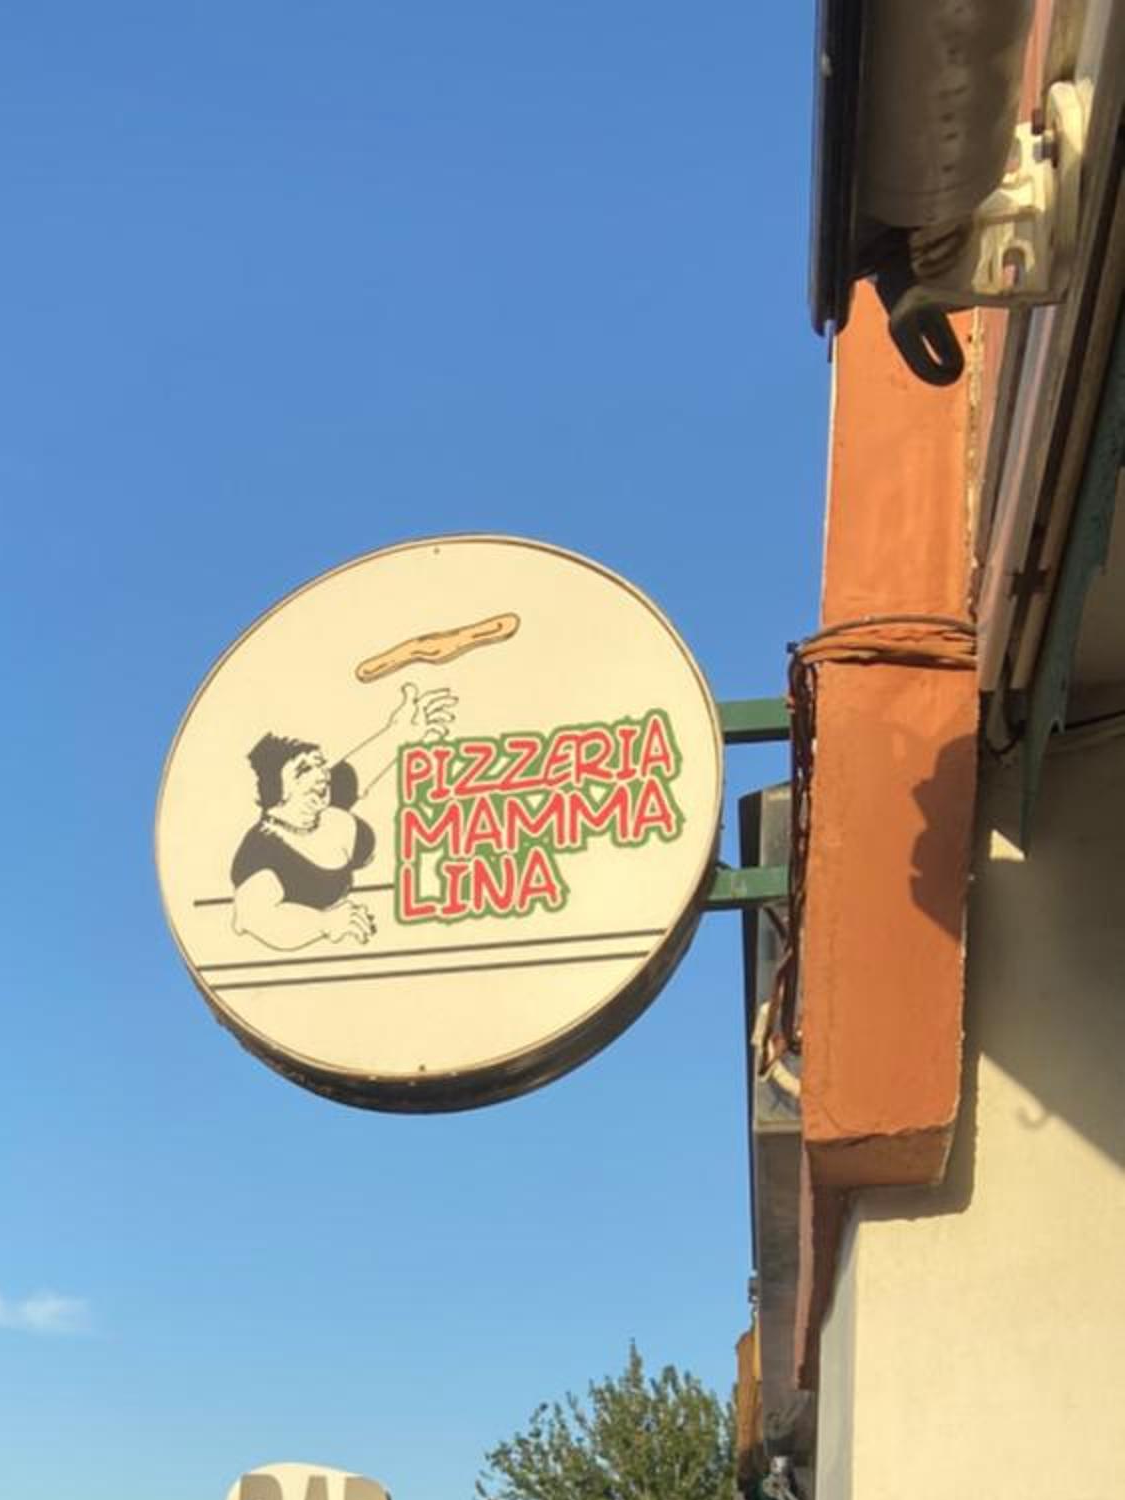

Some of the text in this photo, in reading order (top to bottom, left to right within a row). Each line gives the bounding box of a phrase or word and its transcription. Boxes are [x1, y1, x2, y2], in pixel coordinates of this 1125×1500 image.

[402, 715, 675, 803] PIZZERIA
[402, 778, 675, 860] MAMMA
[401, 849, 562, 918] LINA
